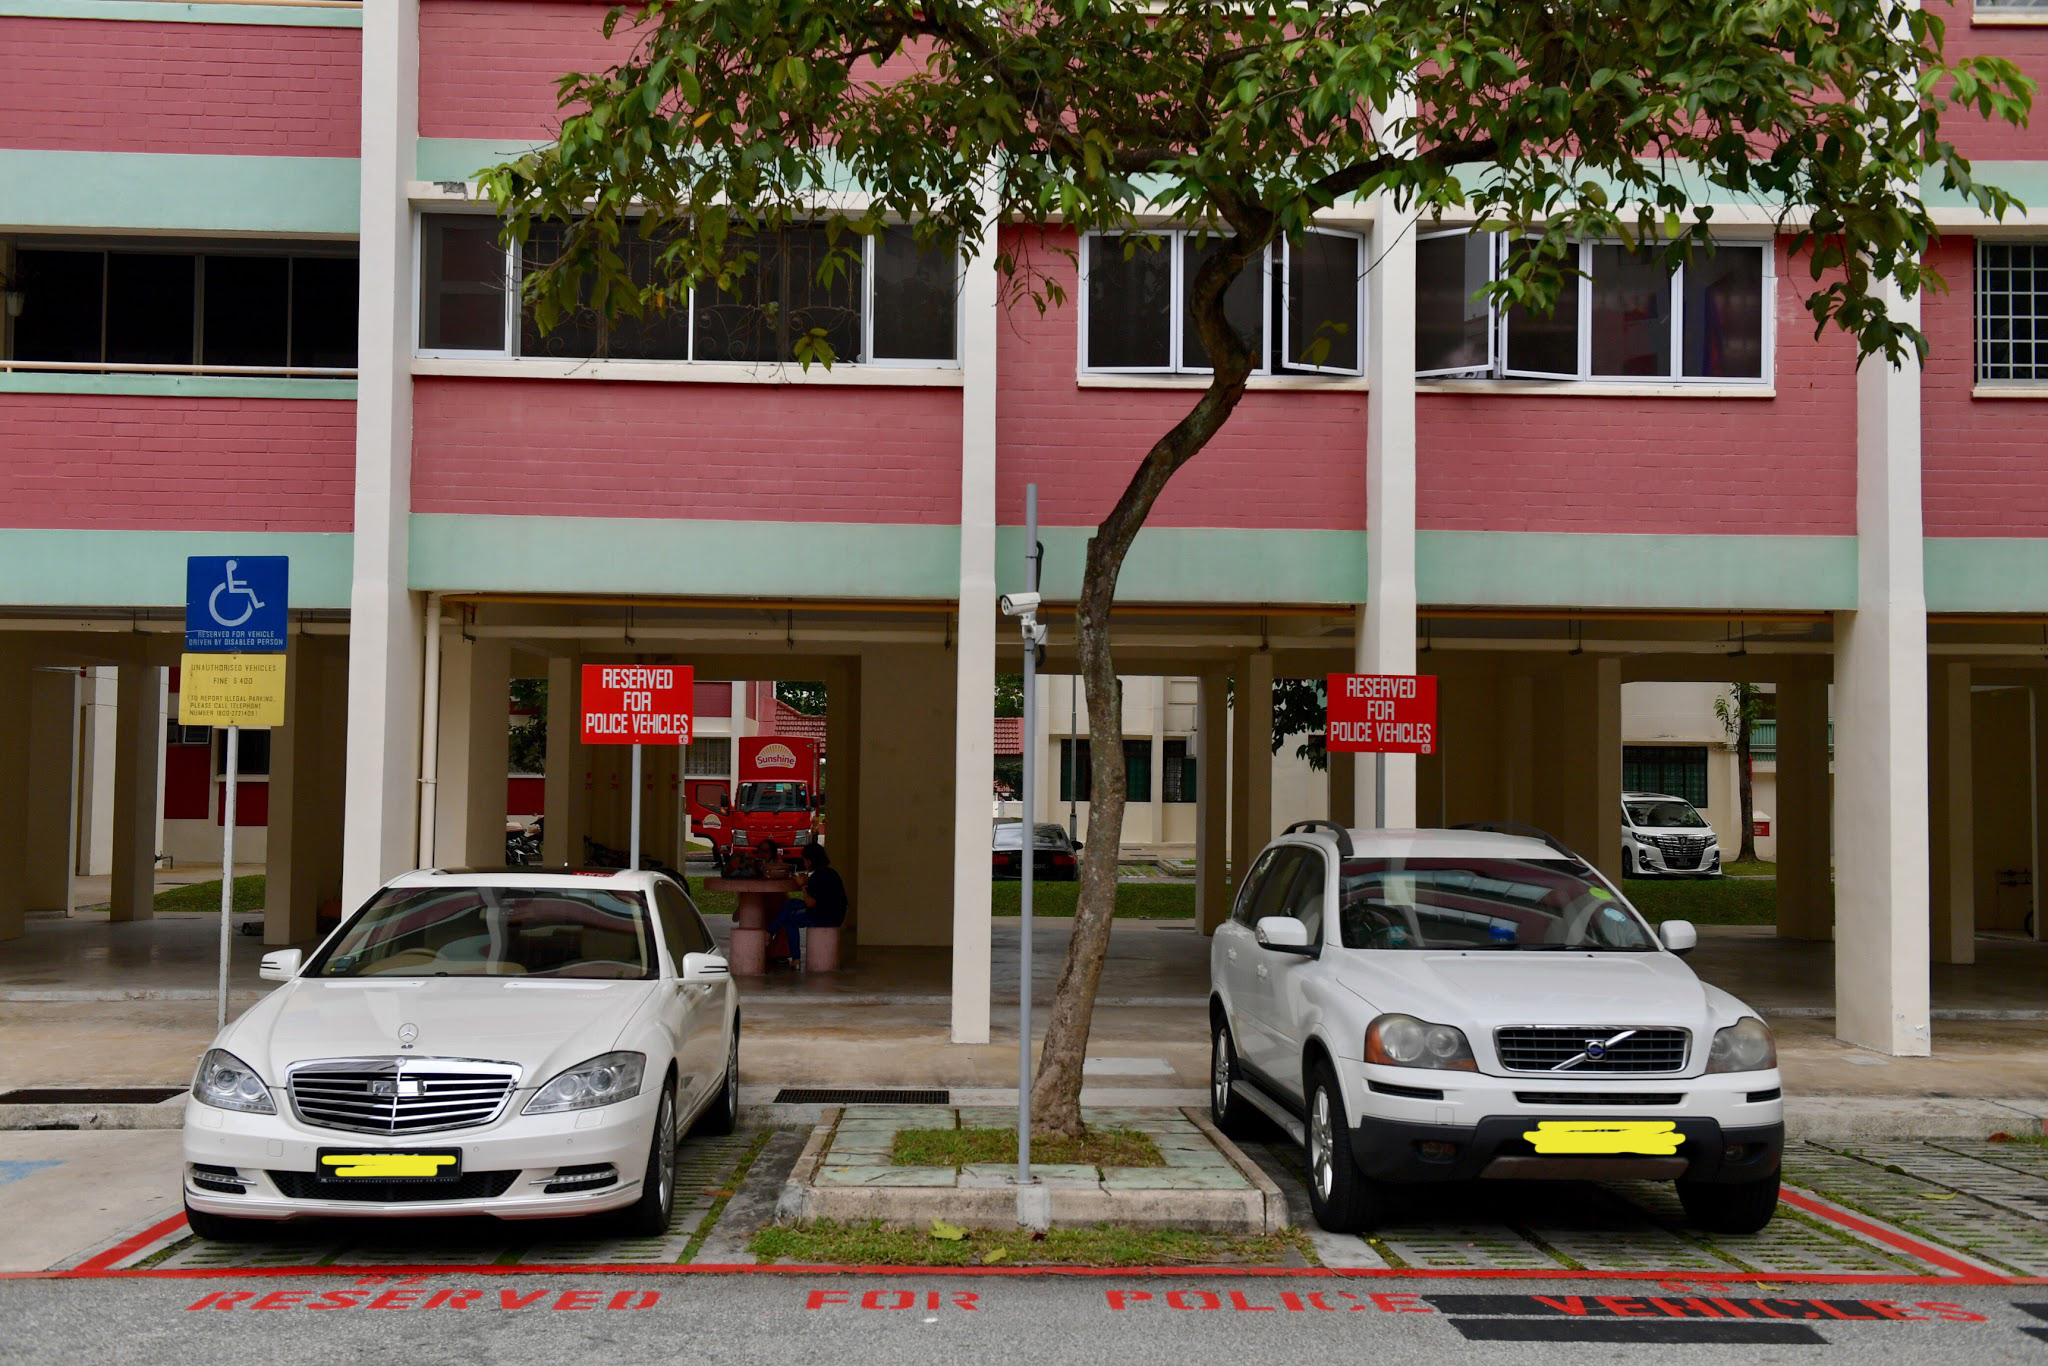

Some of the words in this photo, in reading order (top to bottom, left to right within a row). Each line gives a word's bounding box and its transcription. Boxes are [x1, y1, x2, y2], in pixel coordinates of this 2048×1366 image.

[188, 638, 212, 646] DRIVEN
[244, 664, 277, 672] VEHICLES
[602, 668, 674, 689] RESERVED
[1346, 677, 1417, 699] RESERVED
[623, 691, 652, 712] FOR
[1367, 700, 1395, 721] FOR
[586, 713, 628, 734] POLICE
[632, 713, 689, 735] VEHICLES
[1330, 721, 1373, 743] POLICE
[1376, 722, 1432, 744] VEHICLES
[757, 754, 795, 765] Sunshine
[185, 1289, 661, 1312] RESERVED
[805, 1289, 979, 1311] FOR
[1106, 1289, 1434, 1313] POLICE
[1532, 1295, 1989, 1324] VEHICLES
